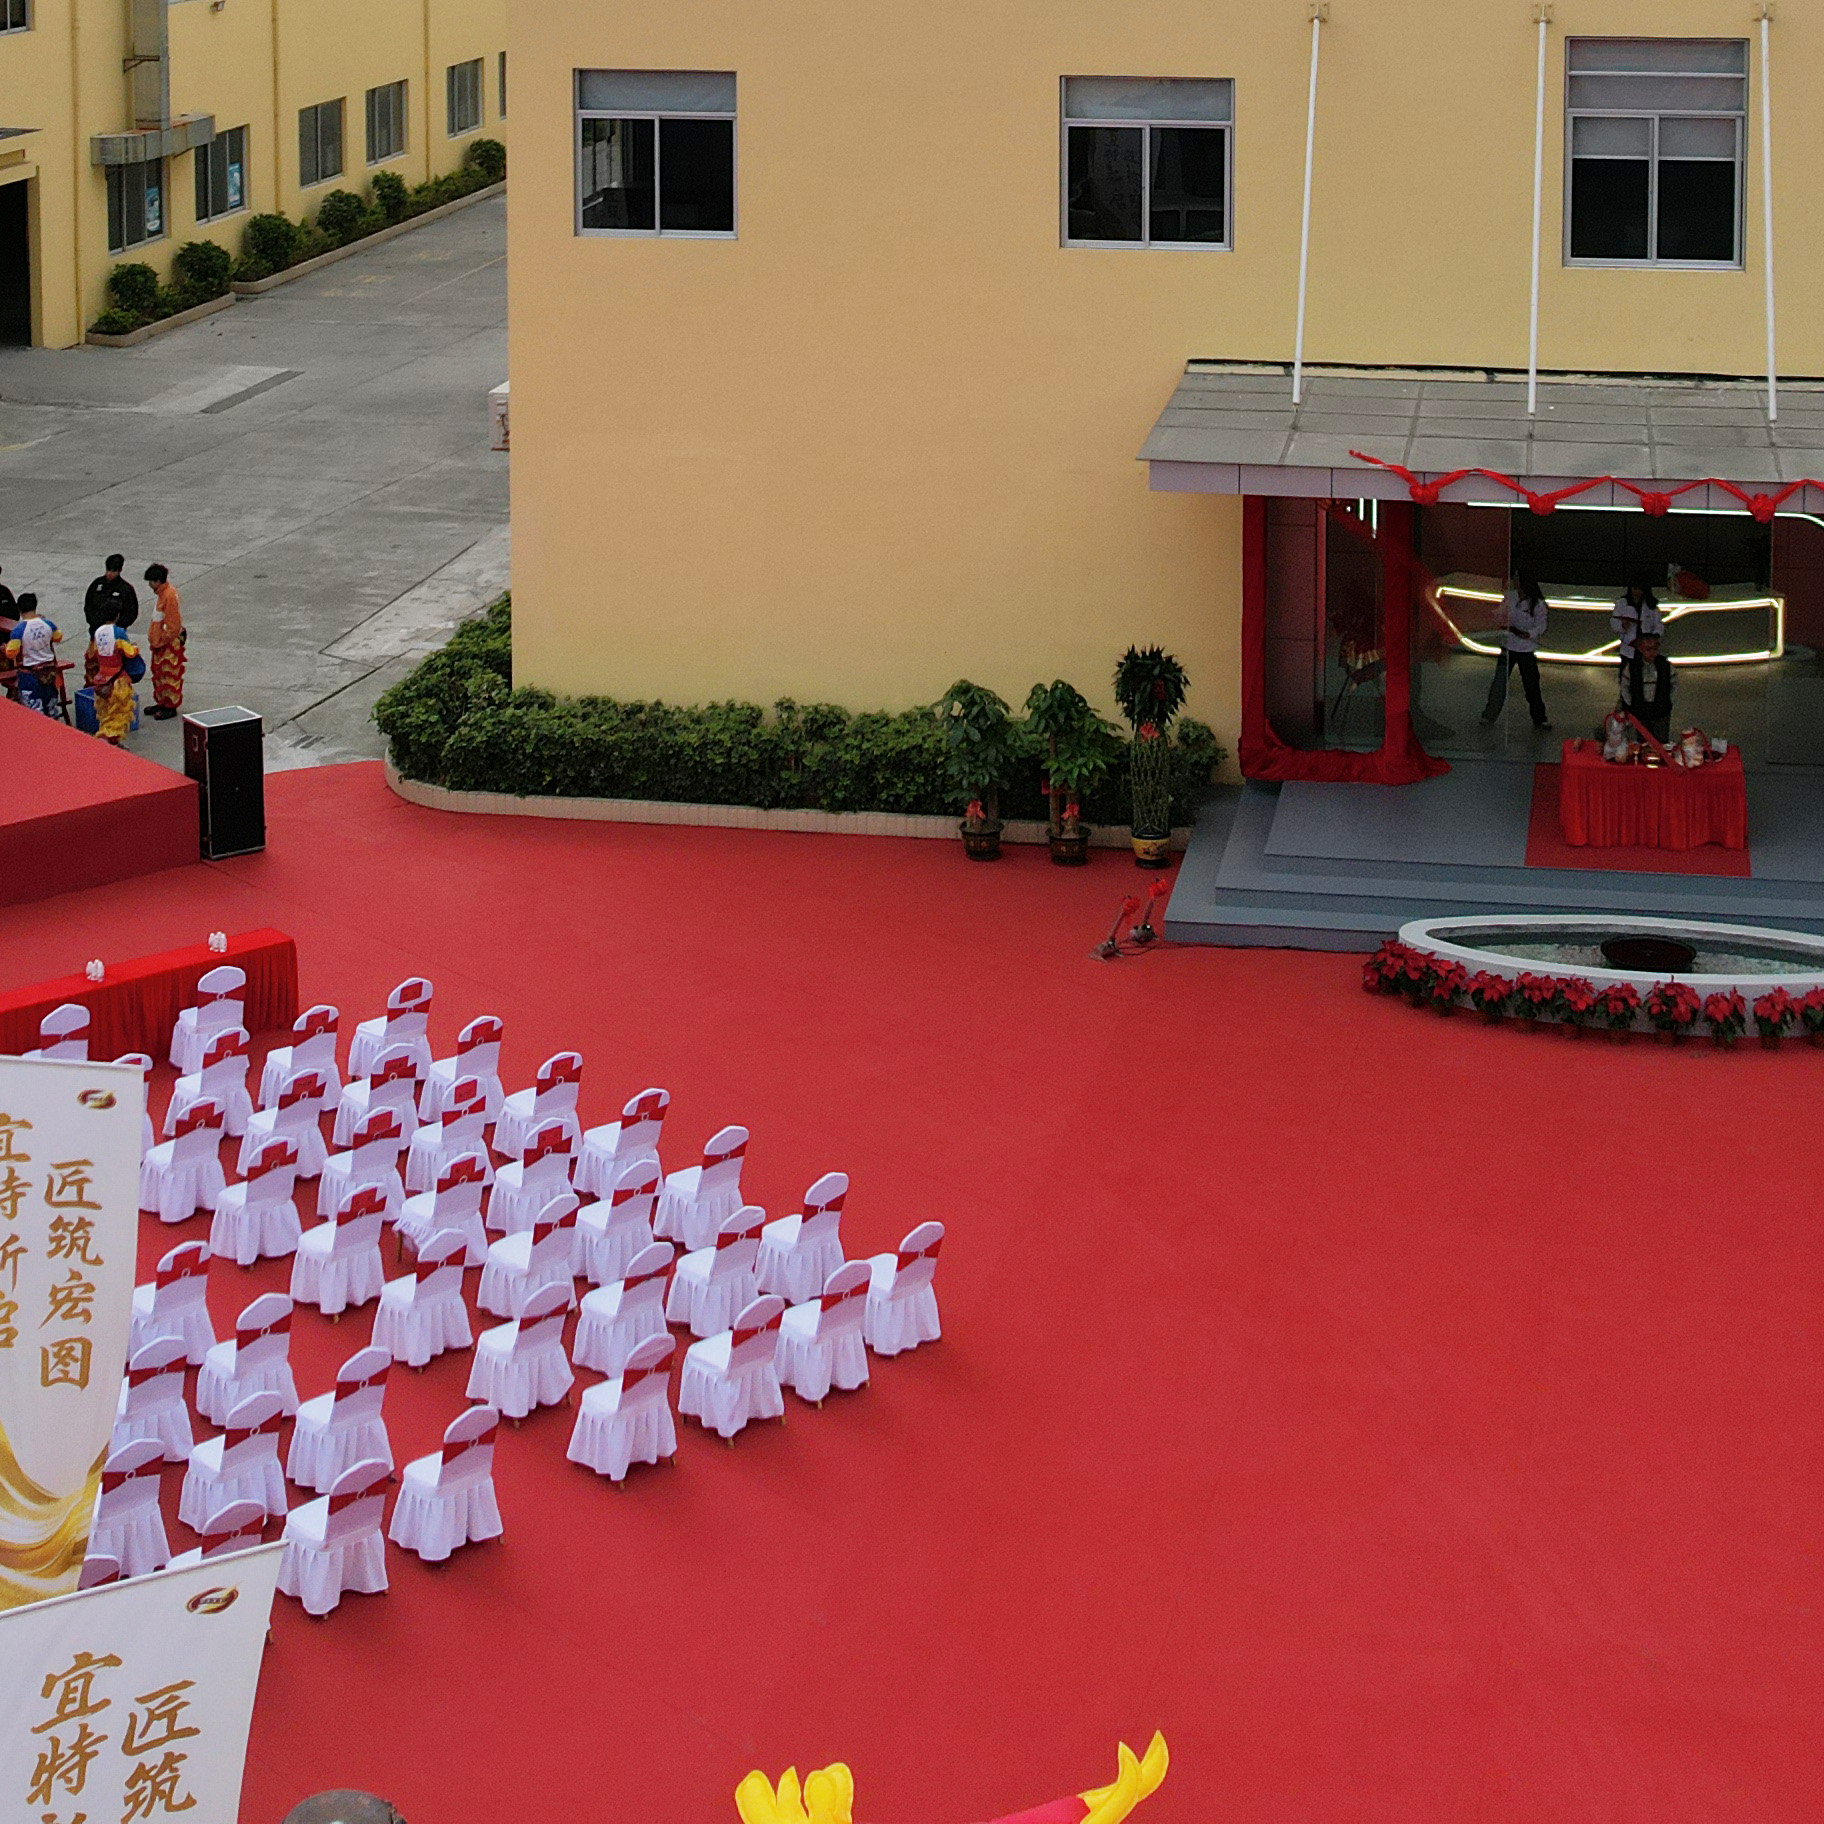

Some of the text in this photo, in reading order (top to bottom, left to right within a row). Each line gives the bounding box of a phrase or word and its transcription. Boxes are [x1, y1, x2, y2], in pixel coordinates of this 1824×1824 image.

[39, 1160, 105, 1390] 匠筑宏图
[26, 1651, 123, 1824] 宜特
[120, 1680, 202, 1824] 匠筑
